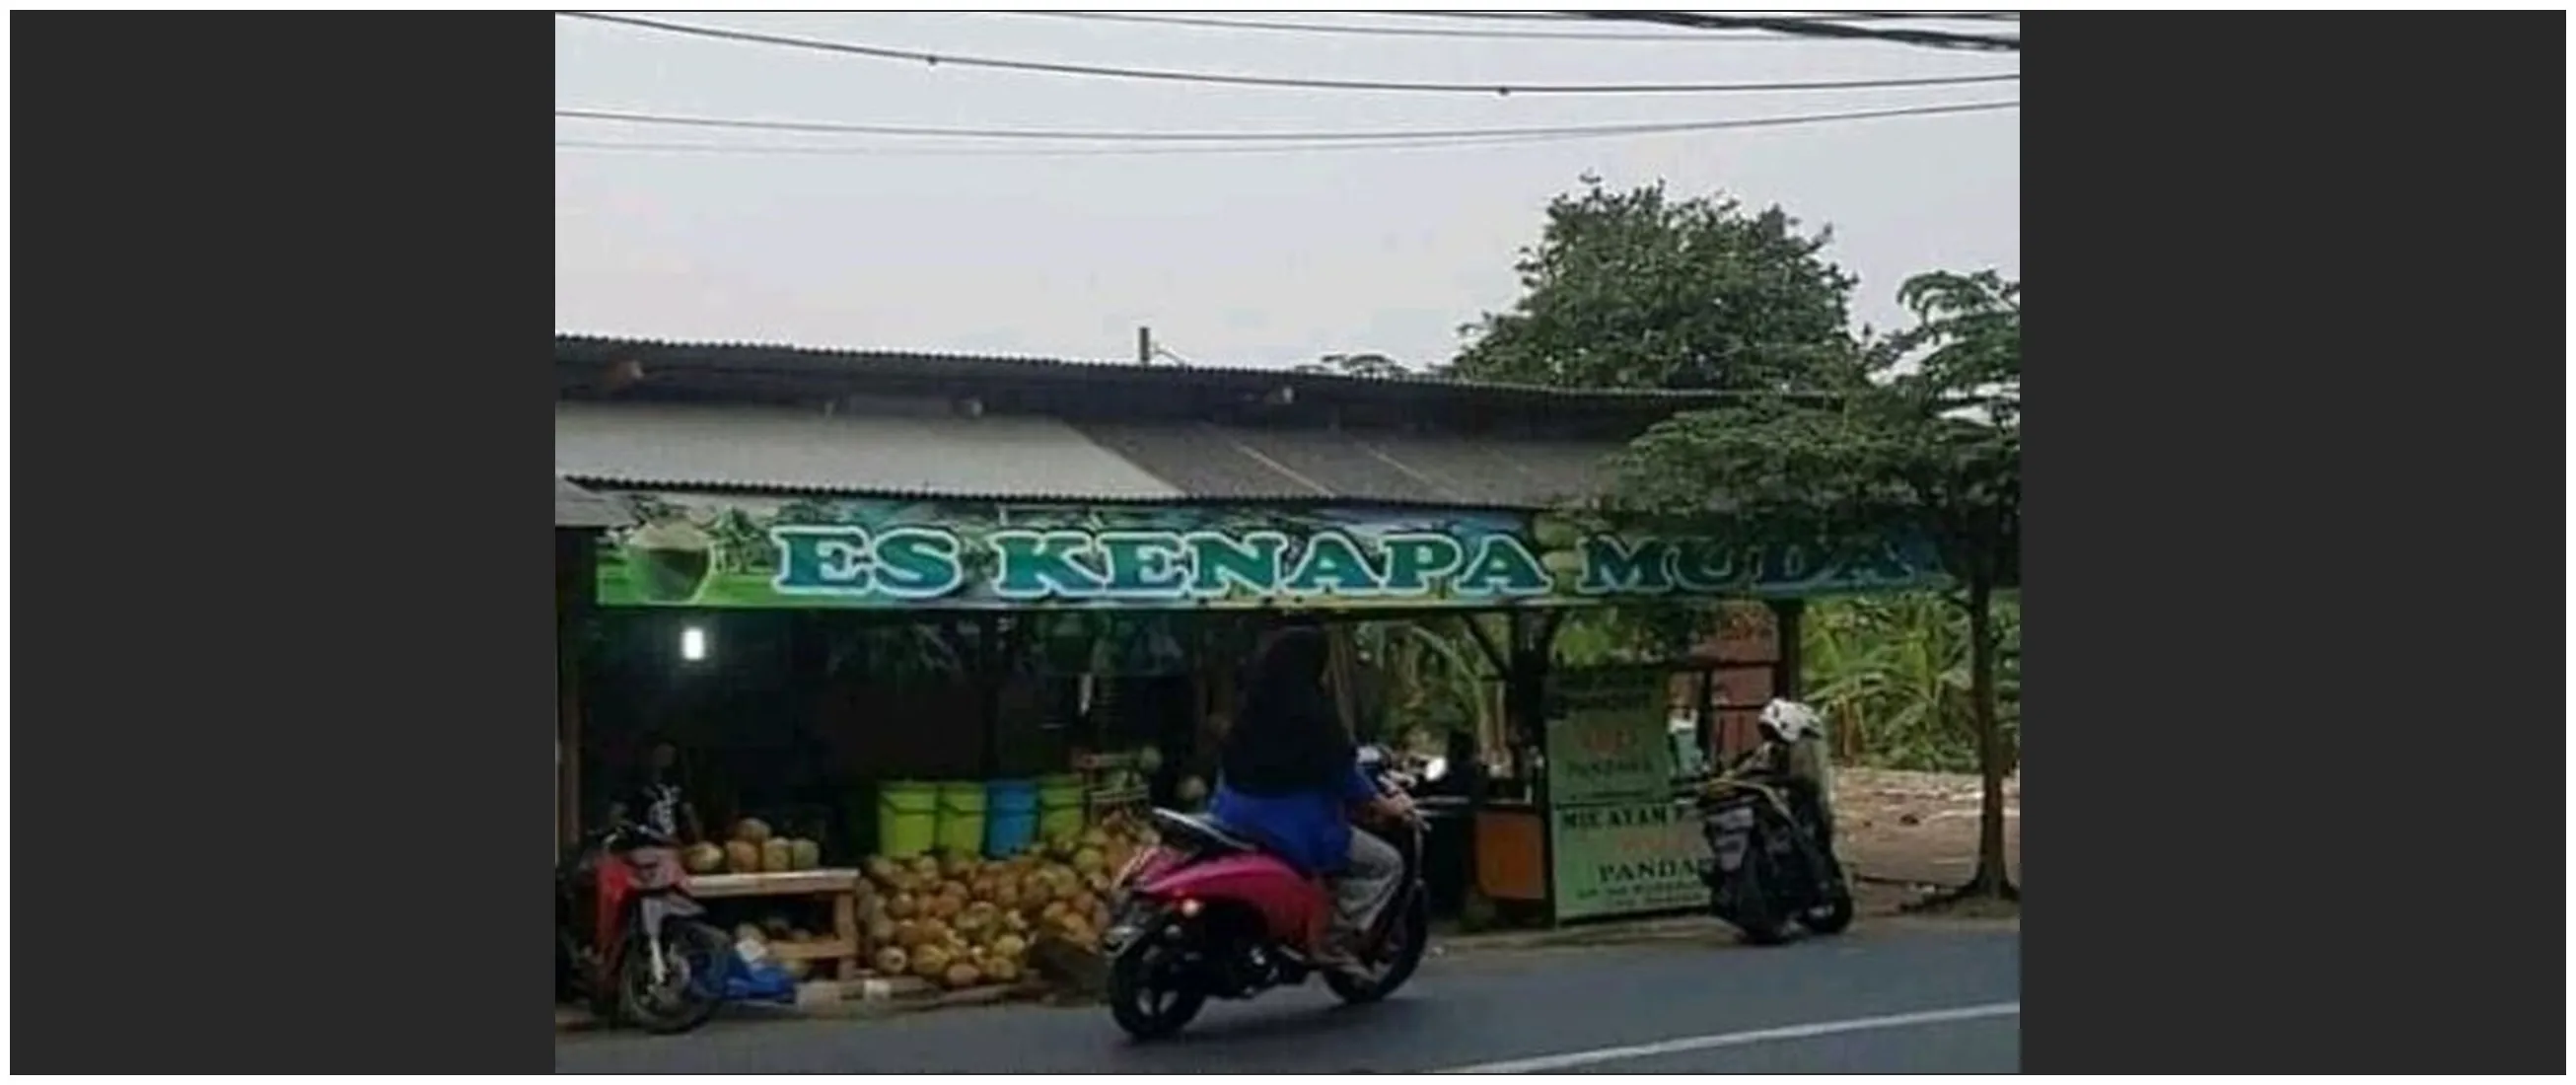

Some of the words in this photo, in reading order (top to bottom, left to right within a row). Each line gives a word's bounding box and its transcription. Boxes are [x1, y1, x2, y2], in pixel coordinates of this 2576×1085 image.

[771, 525, 963, 598] ES
[988, 530, 1552, 598] KENAPA
[1576, 534, 1923, 594] MUDA
[1598, 859, 1700, 883] PANDA
